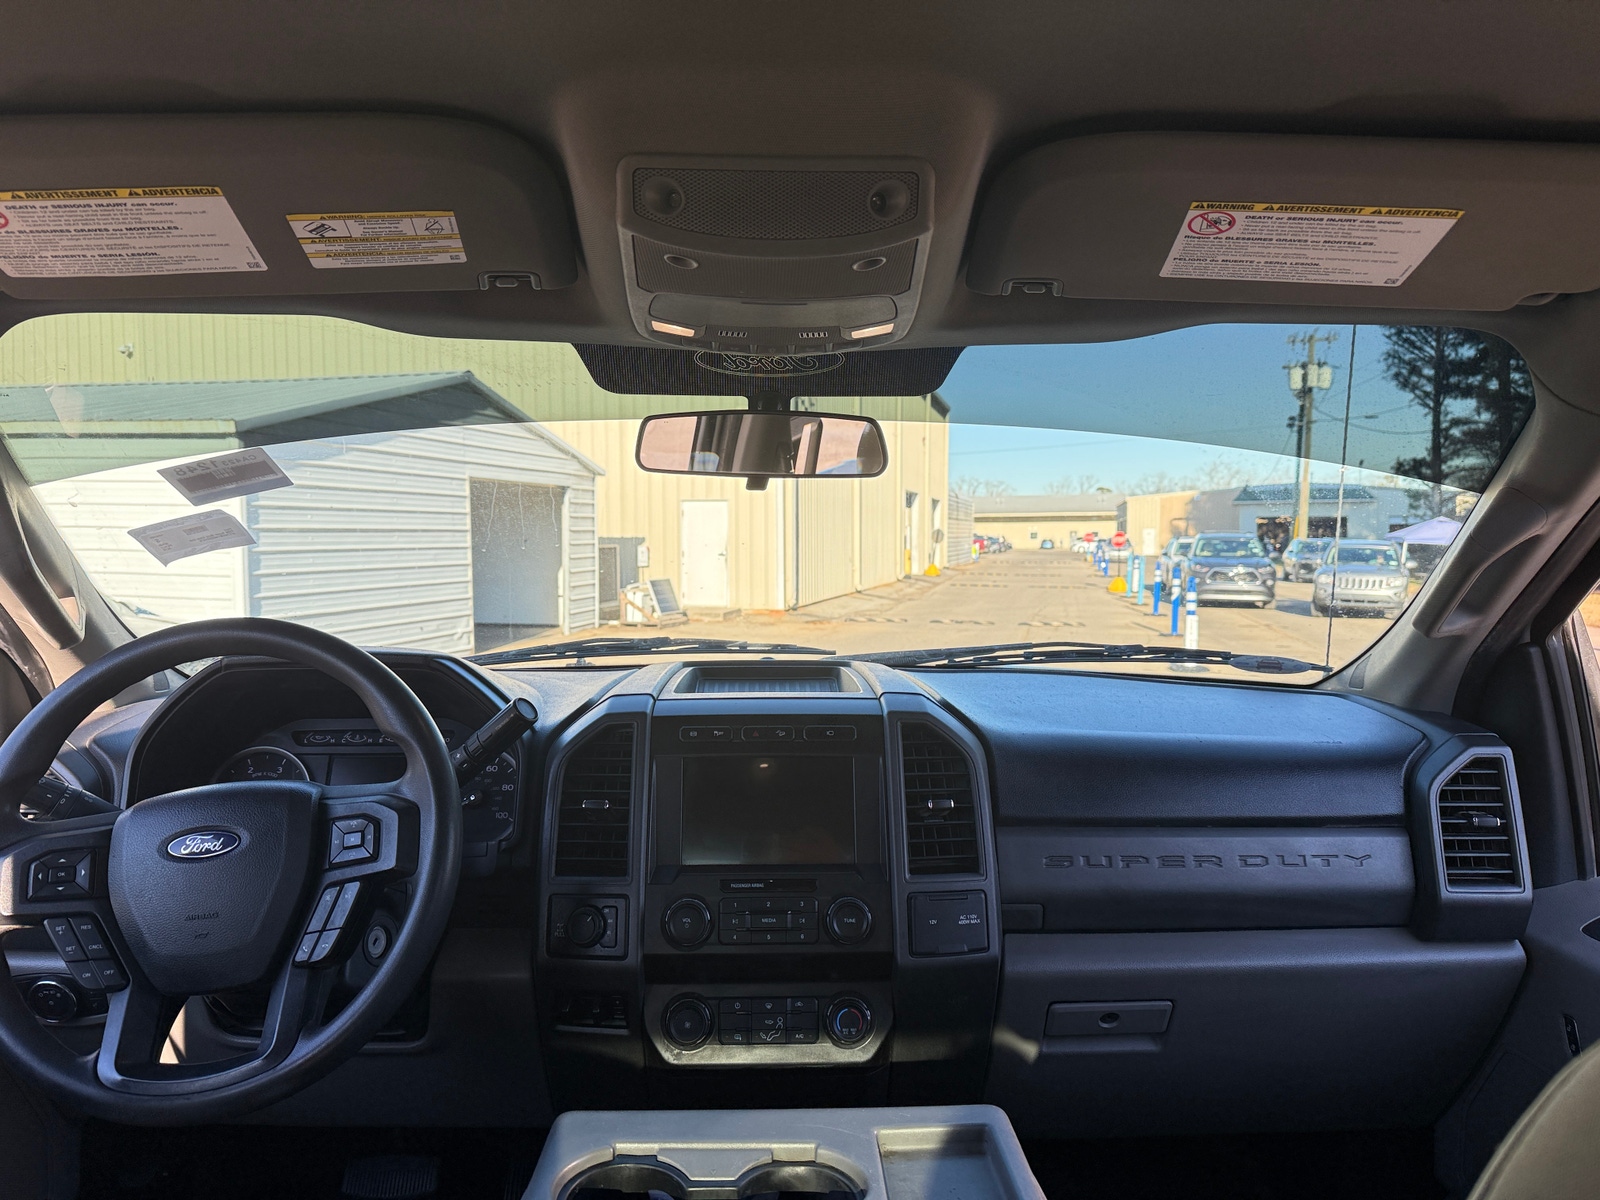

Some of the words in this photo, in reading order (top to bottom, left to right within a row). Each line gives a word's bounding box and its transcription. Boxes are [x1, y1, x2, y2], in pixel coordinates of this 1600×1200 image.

[24, 190, 118, 199] AVERTISSEMENT
[141, 188, 220, 196] ADVERTENCIA
[1205, 202, 1256, 210] WARNING
[1276, 204, 1366, 214] AVERTISSEMENT
[1384, 209, 1460, 217] ADVERTENCIA
[181, 835, 224, 854] Ford
[1043, 855, 1223, 868] SUPER
[1238, 854, 1372, 868] DUTY
